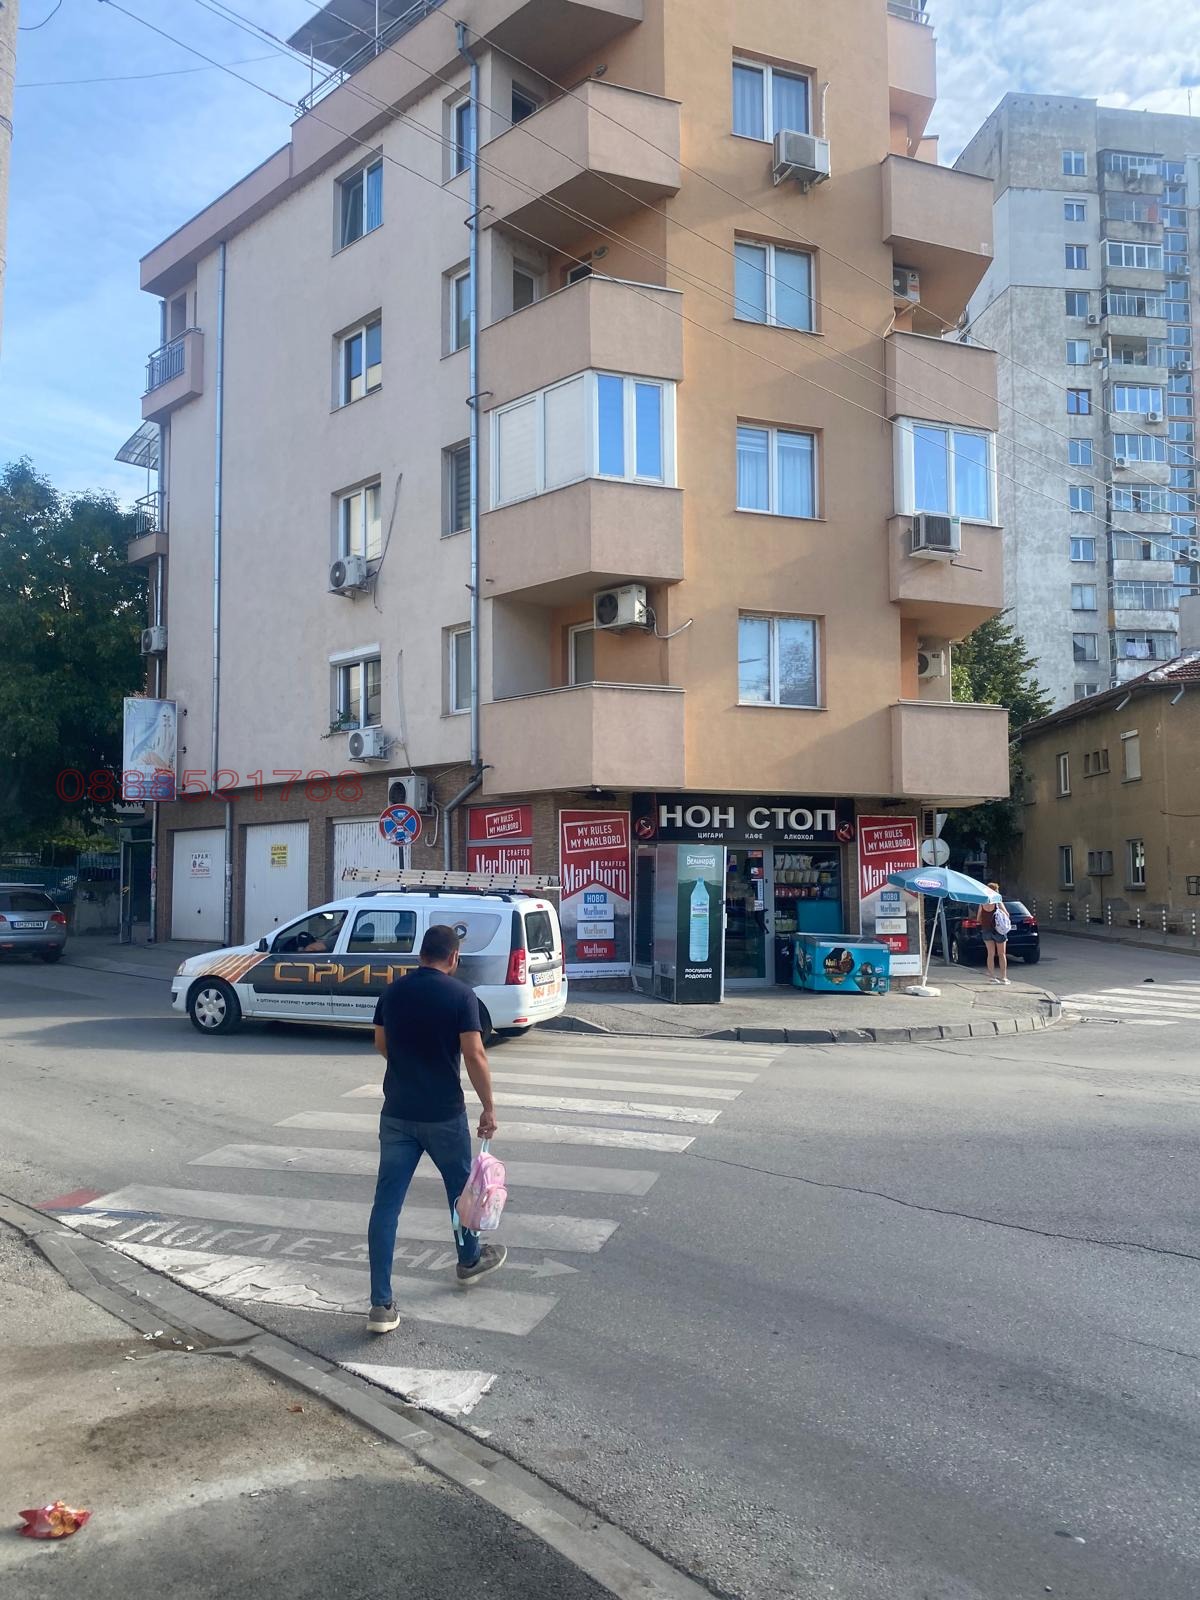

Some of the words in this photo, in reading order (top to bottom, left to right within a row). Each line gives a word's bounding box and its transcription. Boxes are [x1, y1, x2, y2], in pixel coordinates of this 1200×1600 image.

[493, 817, 500, 825] MY
[500, 813, 514, 824] RULES
[658, 805, 735, 829] НОН
[747, 806, 836, 831] СТОП
[496, 821, 519, 833] MARLBORO
[577, 827, 588, 837] MY
[590, 824, 613, 835] RULES
[697, 832, 724, 840] ЦИГАРИ
[783, 833, 814, 841] АЛКОХОЛ
[873, 830, 883, 840] MY
[884, 828, 903, 838] RULES
[570, 838, 582, 849] MY
[583, 834, 621, 847] MARLBORO
[868, 842, 878, 851] MY
[879, 838, 911, 849] MARLBORO
[507, 848, 530, 857] CRAFTED
[475, 849, 530, 875] Marlboro
[563, 860, 626, 895] Marlboro
[862, 861, 905, 893] Marlb
[586, 894, 605, 903] НОВО
[583, 905, 608, 916] Marlboro
[583, 943, 608, 954] Marlboro
[274, 962, 419, 985] СПРИНТ
